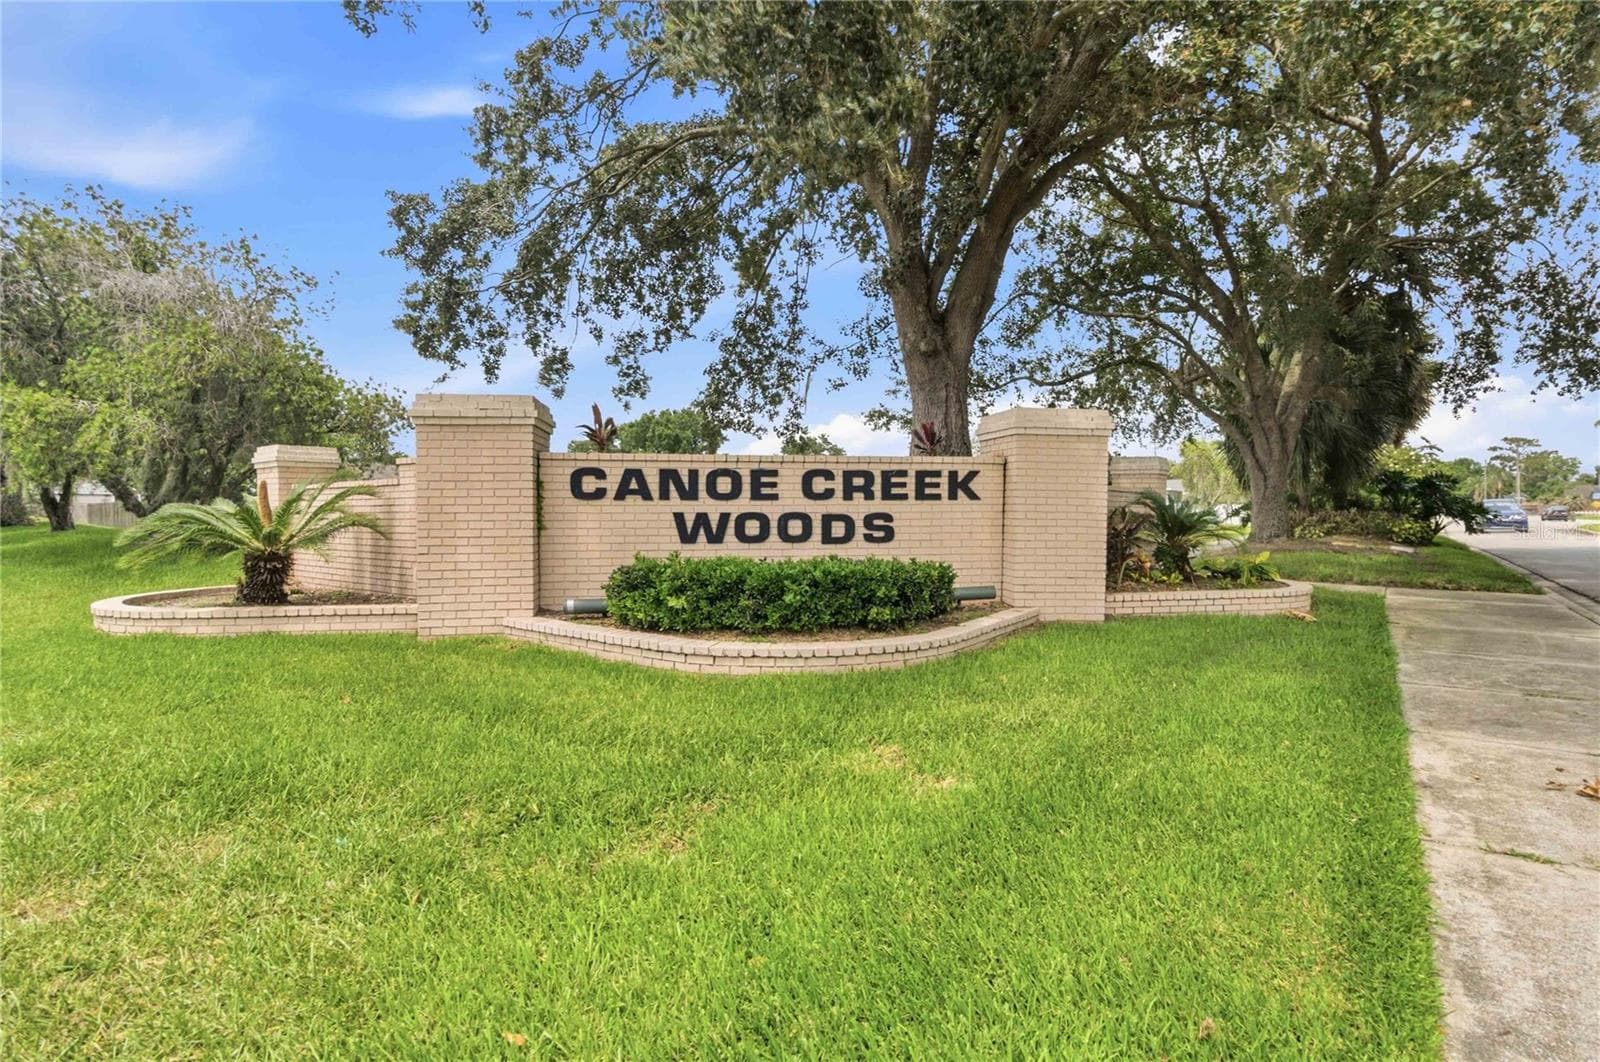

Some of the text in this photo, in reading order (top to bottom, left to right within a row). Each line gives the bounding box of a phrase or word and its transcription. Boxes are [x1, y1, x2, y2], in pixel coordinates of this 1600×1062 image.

[570, 467, 981, 501] CANOE CREEK
[672, 511, 895, 545] WOODS
